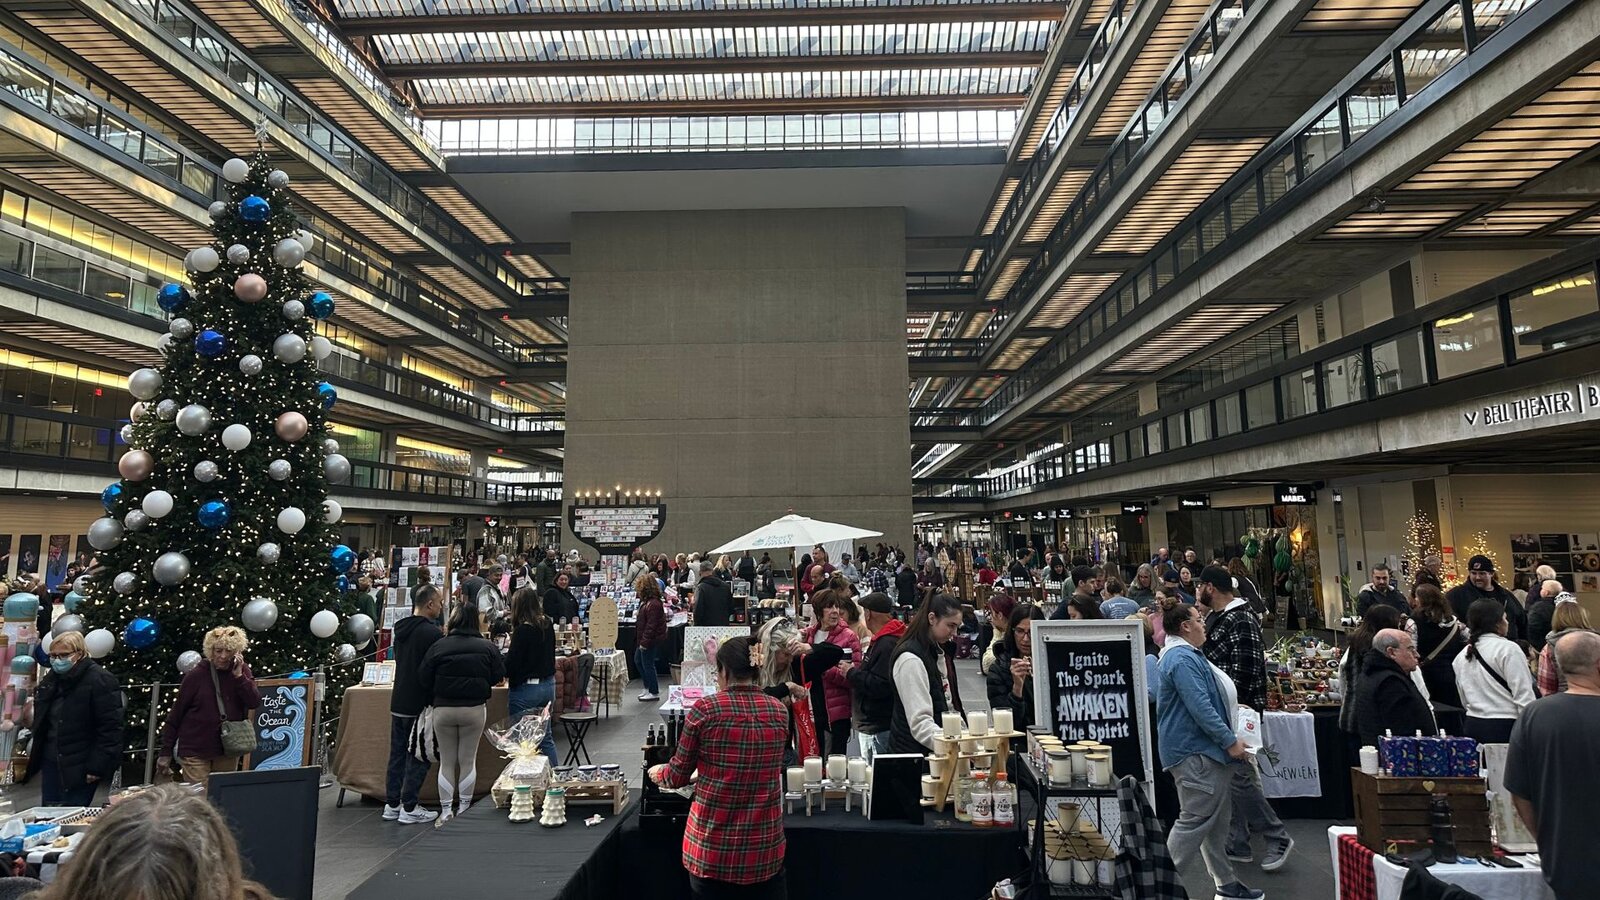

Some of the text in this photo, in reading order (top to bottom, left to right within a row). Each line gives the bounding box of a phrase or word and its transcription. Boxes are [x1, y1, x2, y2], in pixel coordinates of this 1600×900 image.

[1483, 385, 1600, 426] BELL THEATER B
[1281, 494, 1307, 503] MABEL
[1068, 652, 1110, 671] Ignite
[1056, 669, 1127, 689] The Spark
[261, 694, 287, 709] taste
[1057, 692, 1129, 721] AWAKEN
[258, 713, 291, 727] Ocean
[1059, 722, 1130, 743] The Spirit
